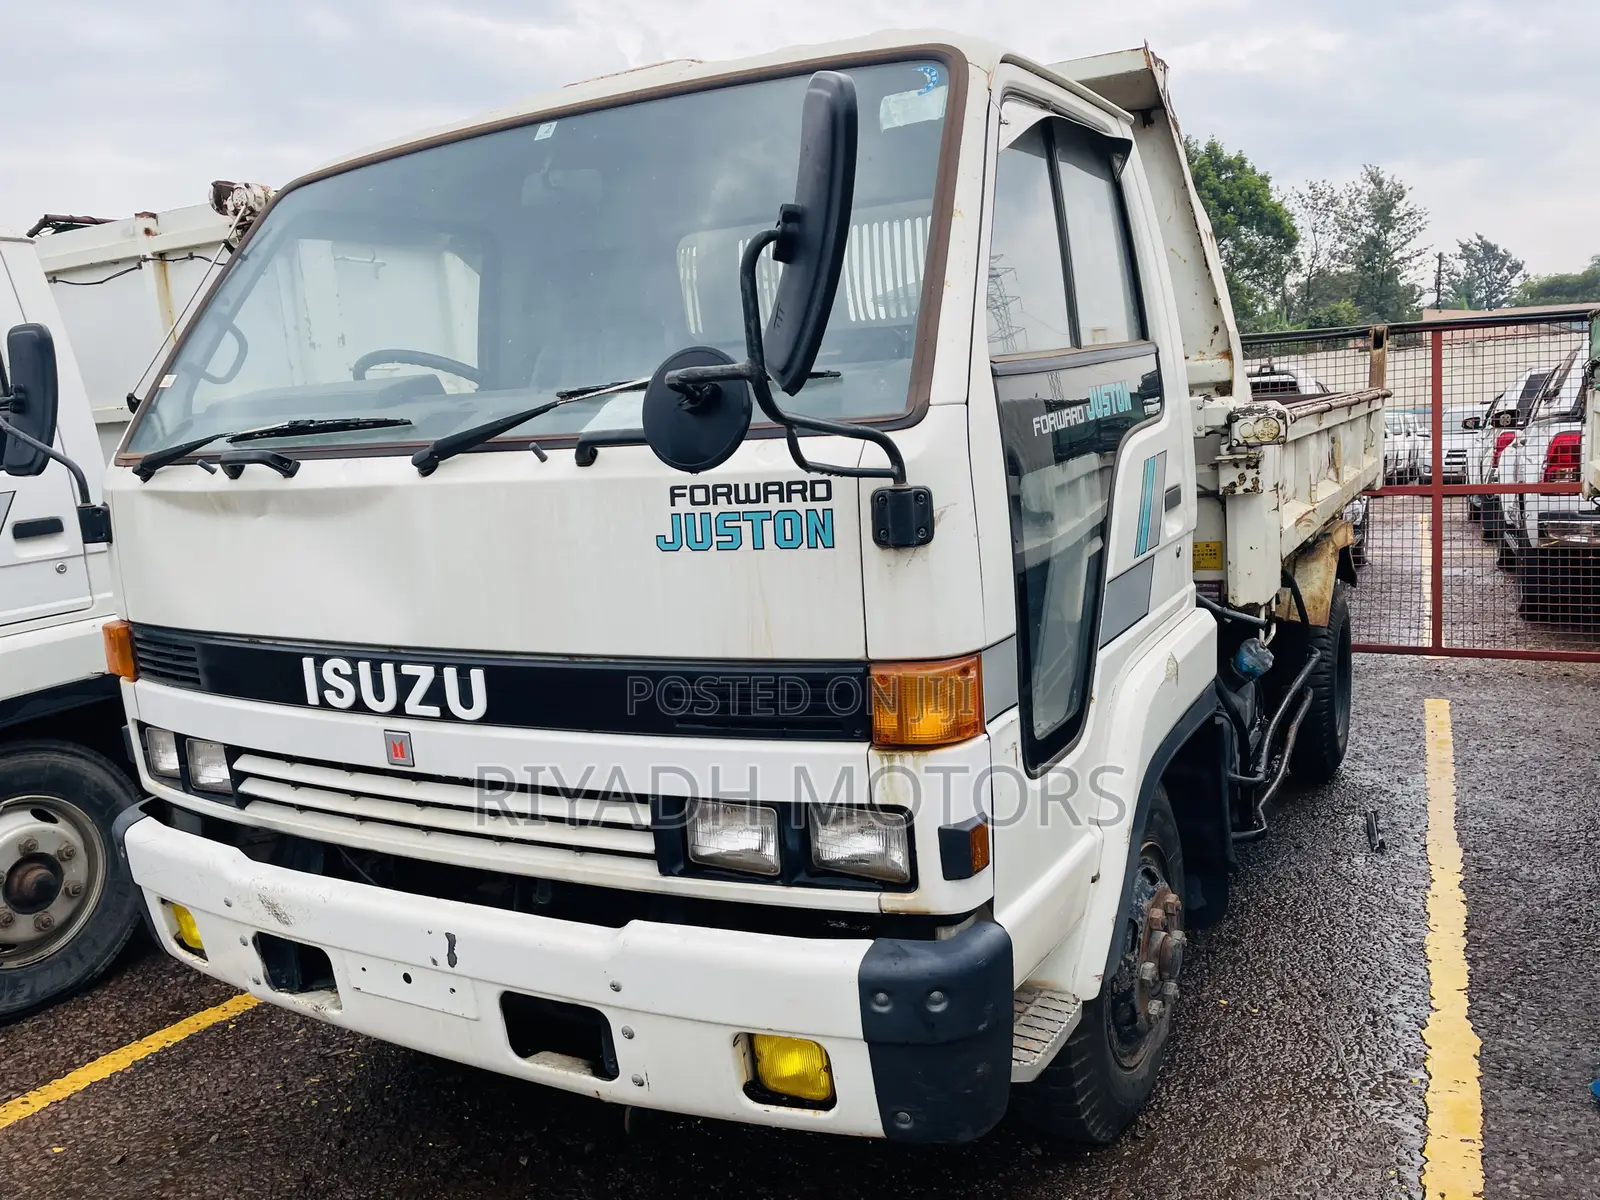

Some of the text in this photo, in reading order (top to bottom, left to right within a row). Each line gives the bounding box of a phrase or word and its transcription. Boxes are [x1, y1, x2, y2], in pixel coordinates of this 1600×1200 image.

[1032, 380, 1132, 437] FORWARD JUSTON
[669, 479, 833, 507] FORWARD
[655, 508, 835, 552] JUSTON
[302, 656, 488, 721] ISUZU
